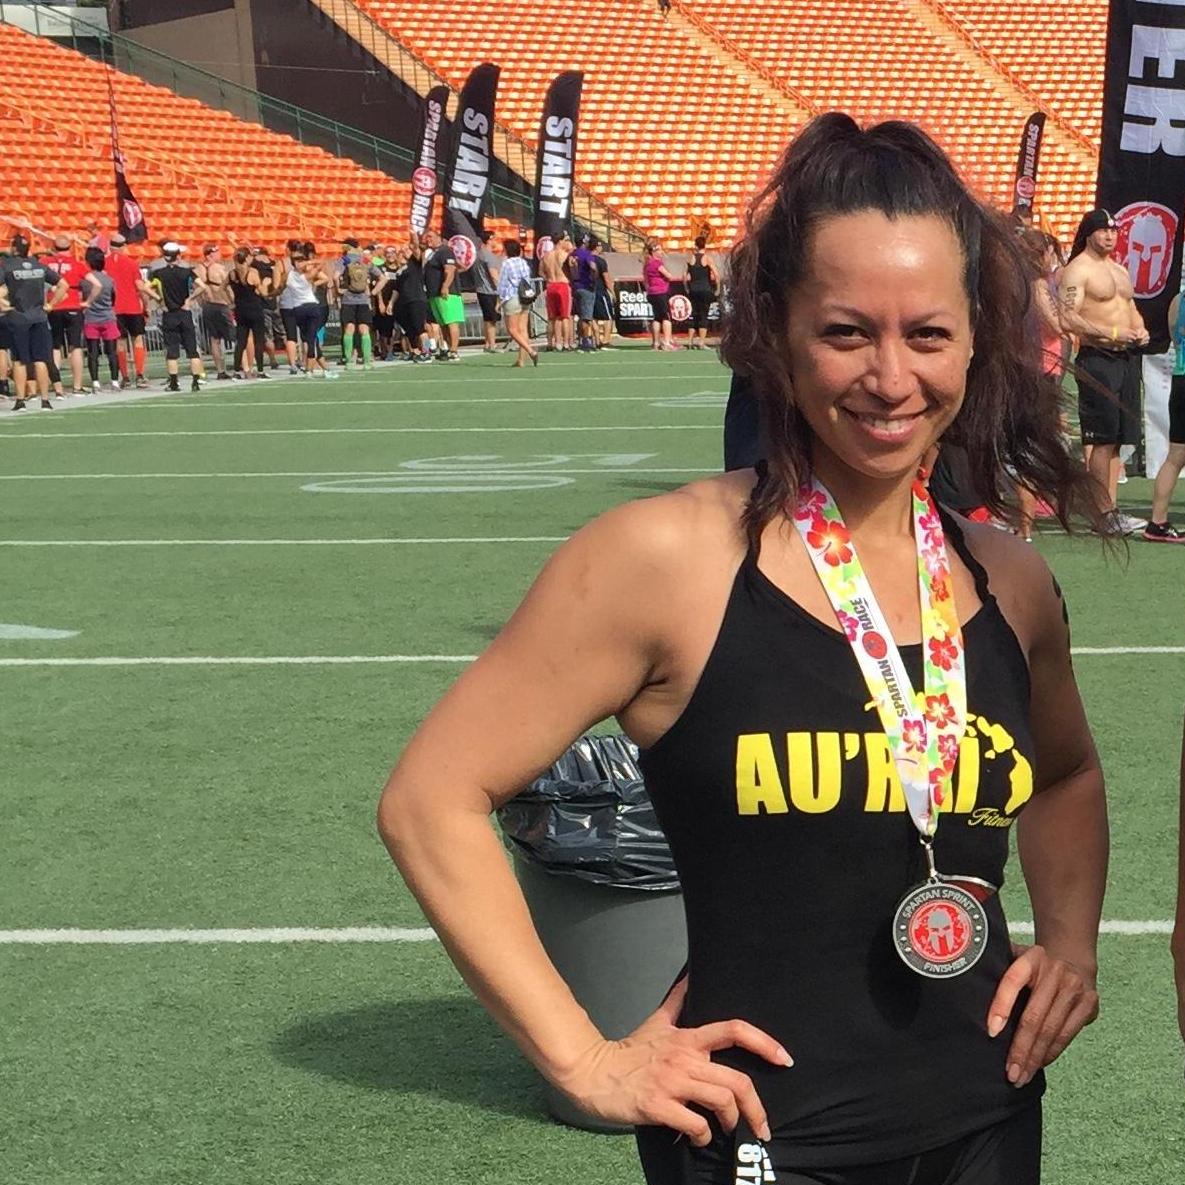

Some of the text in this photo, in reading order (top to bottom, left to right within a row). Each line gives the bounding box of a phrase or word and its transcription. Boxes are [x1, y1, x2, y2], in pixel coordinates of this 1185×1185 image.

[420, 99, 441, 169] SPARTAN
[1023, 123, 1039, 177] SPARTAN
[449, 106, 489, 220] START
[539, 115, 573, 219] START
[850, 597, 875, 631] RACE
[878, 659, 909, 718] SPARTAN
[903, 889, 976, 918] SPARTAN SPRINT
[924, 957, 968, 972] FINISHER
